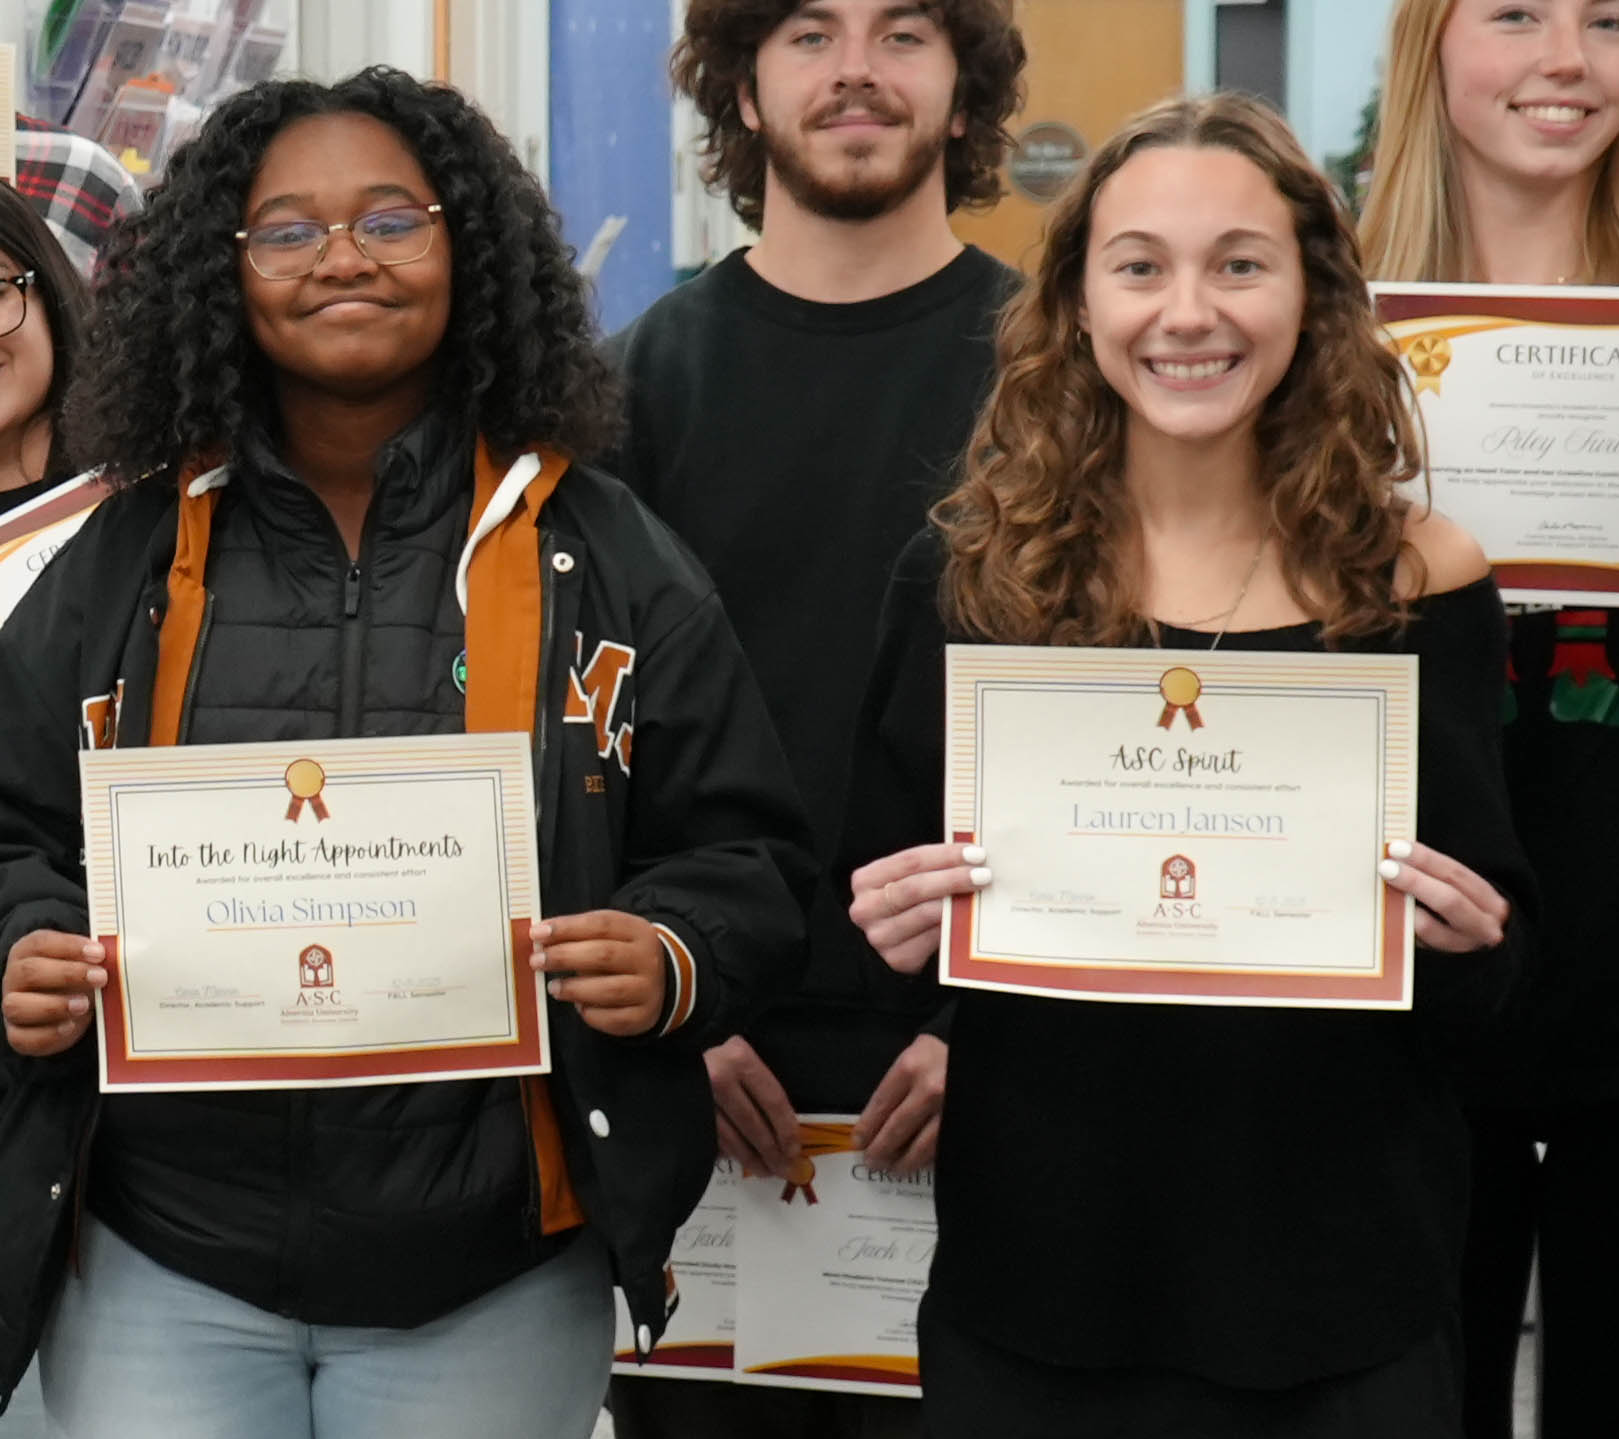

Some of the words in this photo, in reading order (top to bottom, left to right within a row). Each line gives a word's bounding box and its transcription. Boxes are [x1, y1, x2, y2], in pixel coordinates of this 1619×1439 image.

[1481, 426, 1556, 459] Riley
[1110, 745, 1166, 772] ASC
[1173, 747, 1243, 776] Spirit
[1073, 804, 1176, 831] Lauren
[1181, 806, 1284, 834] Janson
[147, 844, 190, 869] Into
[199, 842, 234, 867] the
[242, 839, 306, 869] Night
[311, 834, 464, 867] Appointments
[206, 897, 284, 925] Olivia
[292, 898, 417, 928] Simpson
